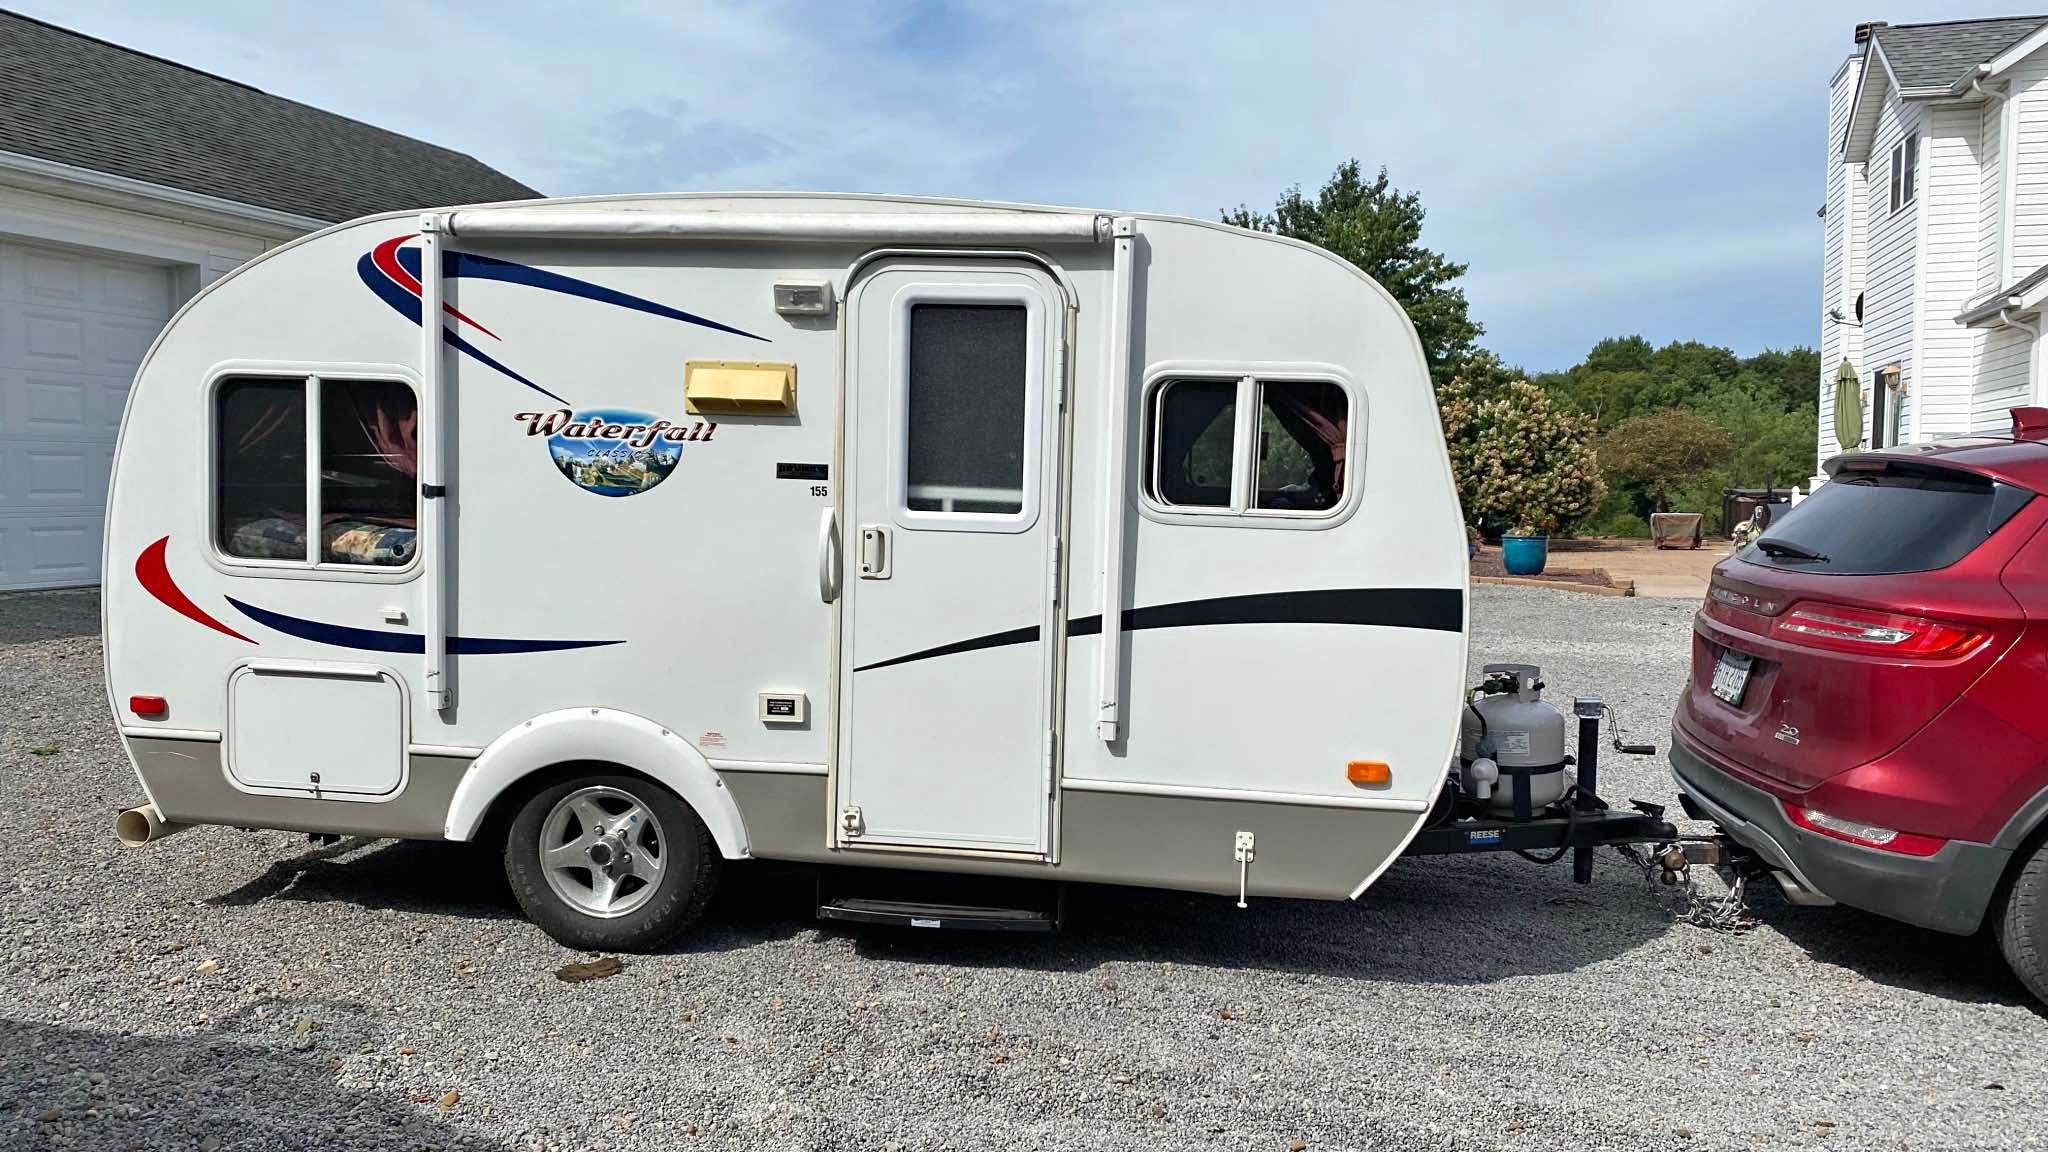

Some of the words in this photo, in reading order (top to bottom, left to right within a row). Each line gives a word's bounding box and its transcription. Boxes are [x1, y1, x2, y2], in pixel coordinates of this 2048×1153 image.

[514, 409, 718, 448] Waterfall
[587, 449, 642, 459] CLASSIC
[810, 486, 828, 497] 155
[1470, 830, 1500, 840] REESE
